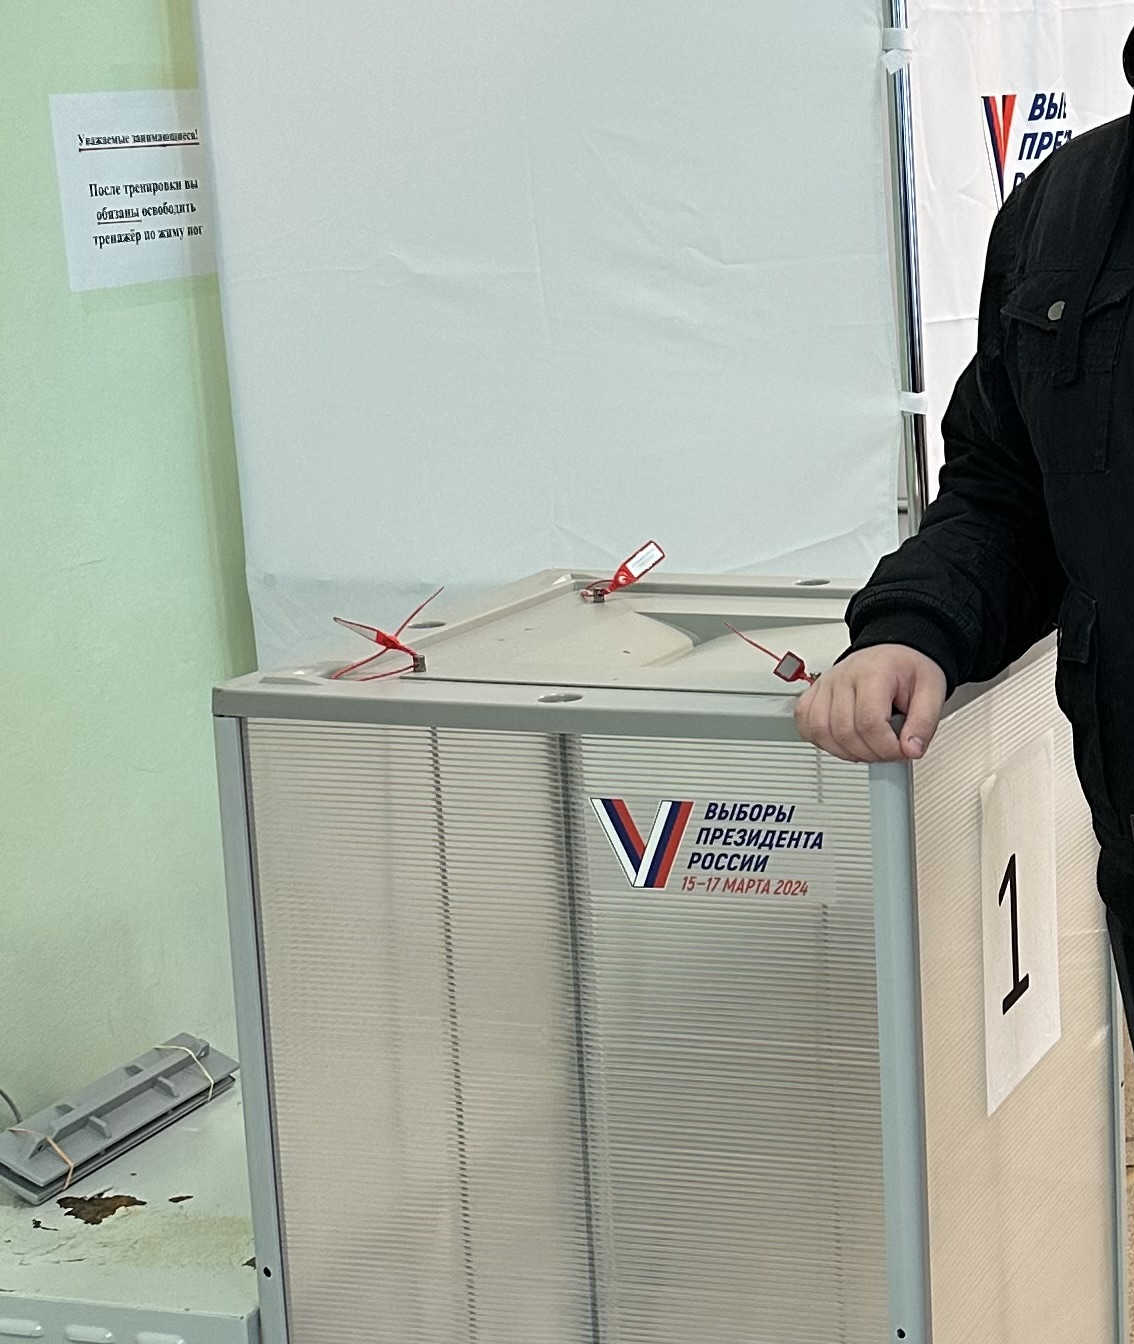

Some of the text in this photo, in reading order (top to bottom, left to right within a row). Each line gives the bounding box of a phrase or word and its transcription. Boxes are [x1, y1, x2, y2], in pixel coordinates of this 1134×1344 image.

[77, 133, 130, 146] Уважаемые
[89, 179, 199, 198] После тренировки вы
[96, 202, 197, 221] обязаны освободить
[93, 228, 142, 249] тренажёр
[144, 230, 156, 241] по
[158, 227, 185, 240] жиму
[704, 802, 795, 823] ВЫБОРЫ
[695, 827, 824, 851] ПРЕЗИДЕНТА
[687, 852, 769, 873] РОССИИ
[722, 878, 770, 895] МАРТА
[773, 880, 809, 897] 2024
[998, 853, 1030, 1016] 1
